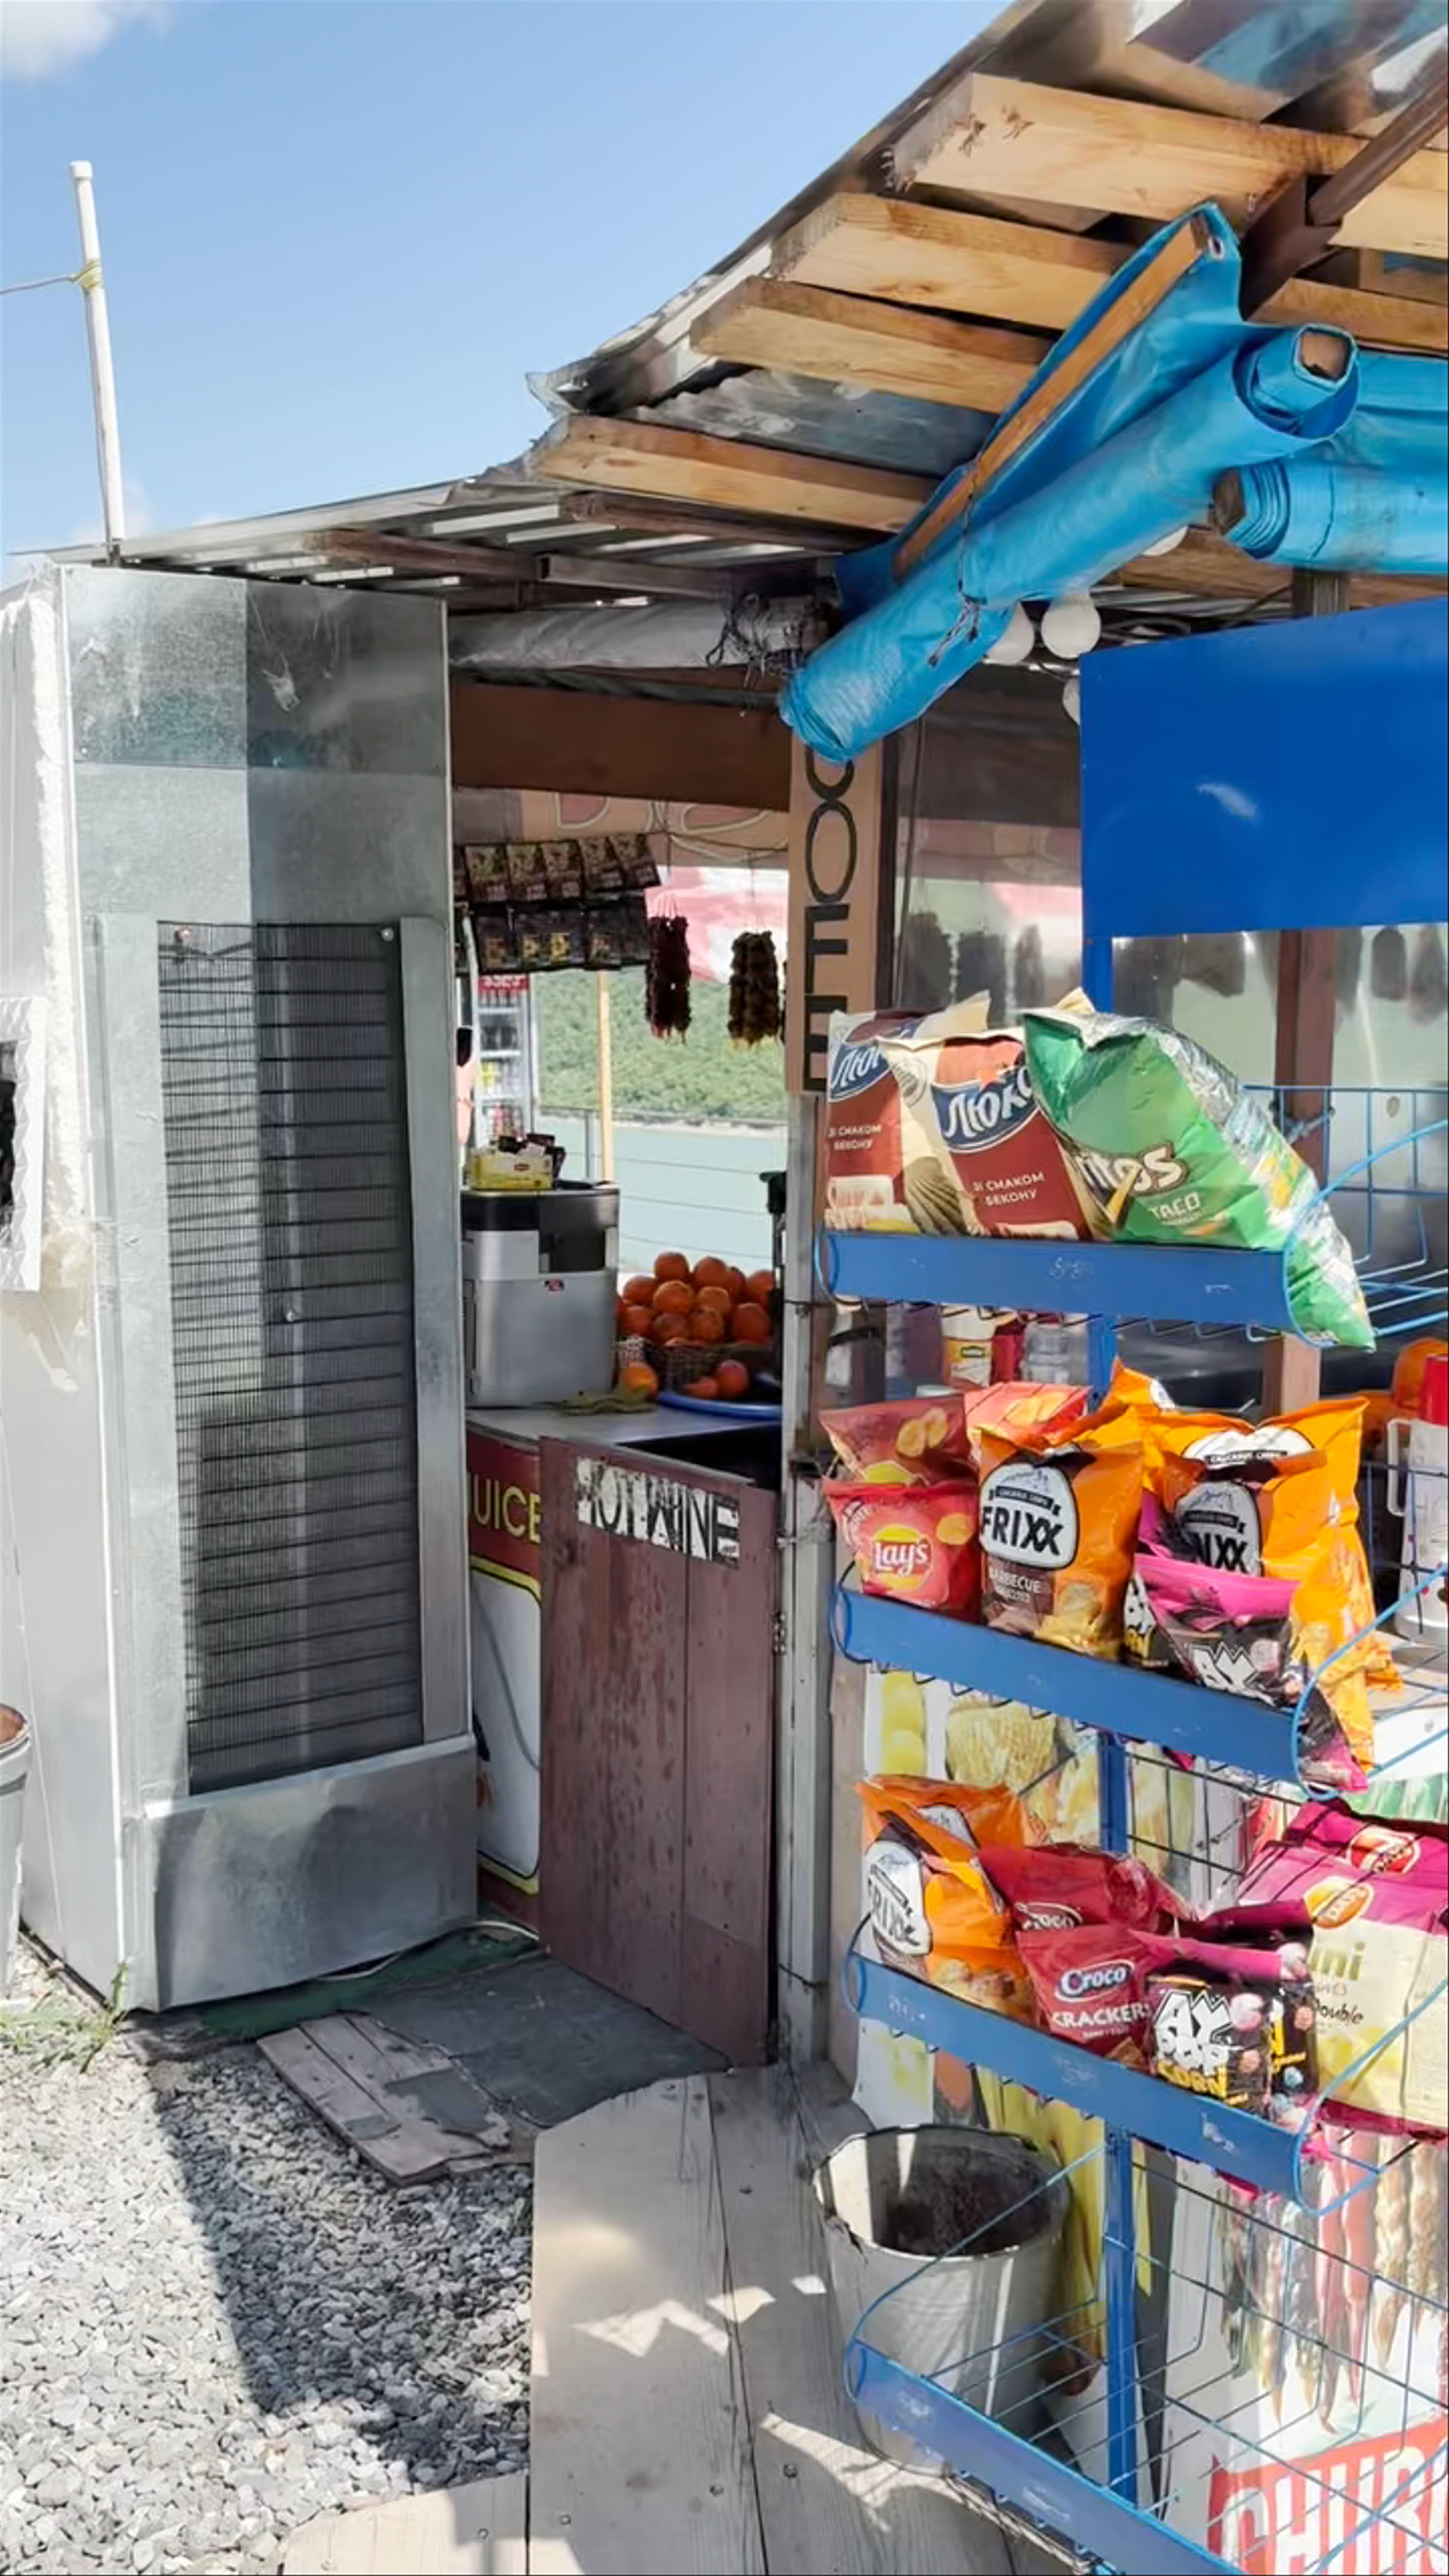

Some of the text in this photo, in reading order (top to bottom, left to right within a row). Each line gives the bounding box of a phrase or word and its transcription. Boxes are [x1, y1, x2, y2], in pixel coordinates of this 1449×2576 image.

[986, 1172, 1045, 1191] СМАКОМ
[984, 1189, 1037, 1206] БЕКОНУ
[1148, 1192, 1201, 1220] TACO
[982, 1506, 1064, 1556] FRIXX
[1061, 1967, 1126, 1995] Croco
